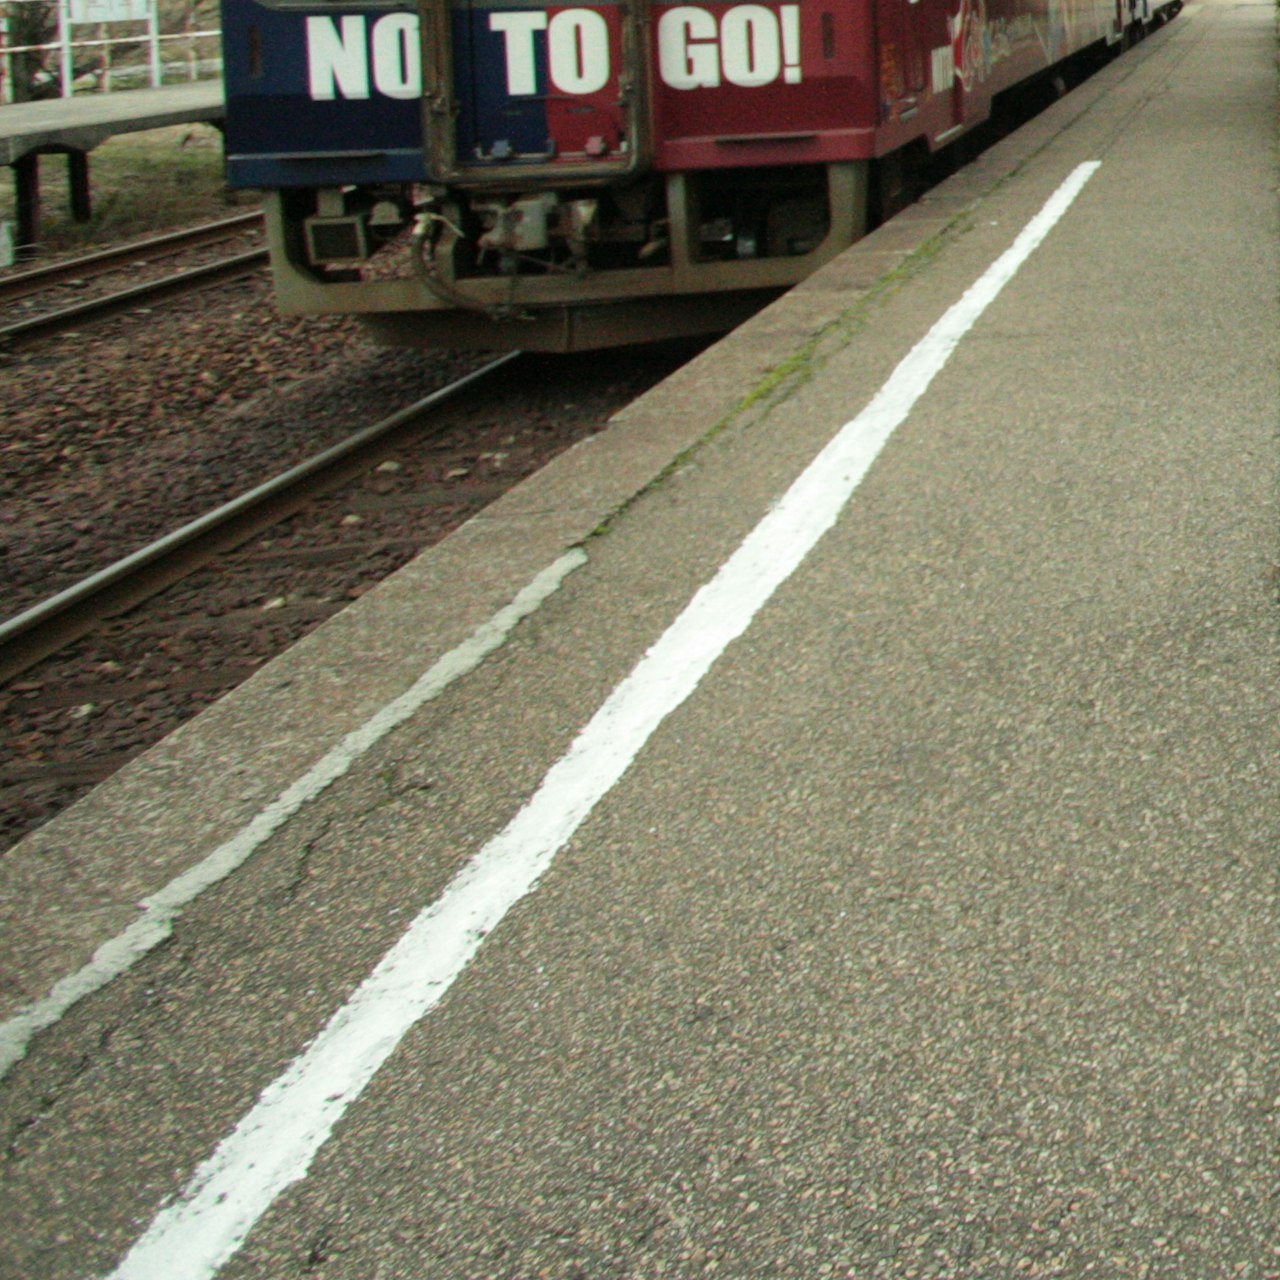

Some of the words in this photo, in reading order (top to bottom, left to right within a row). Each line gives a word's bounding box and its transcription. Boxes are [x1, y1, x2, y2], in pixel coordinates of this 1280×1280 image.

[306, 12, 422, 101] NO
[489, 8, 610, 95] TO
[657, 4, 803, 90] GO!
